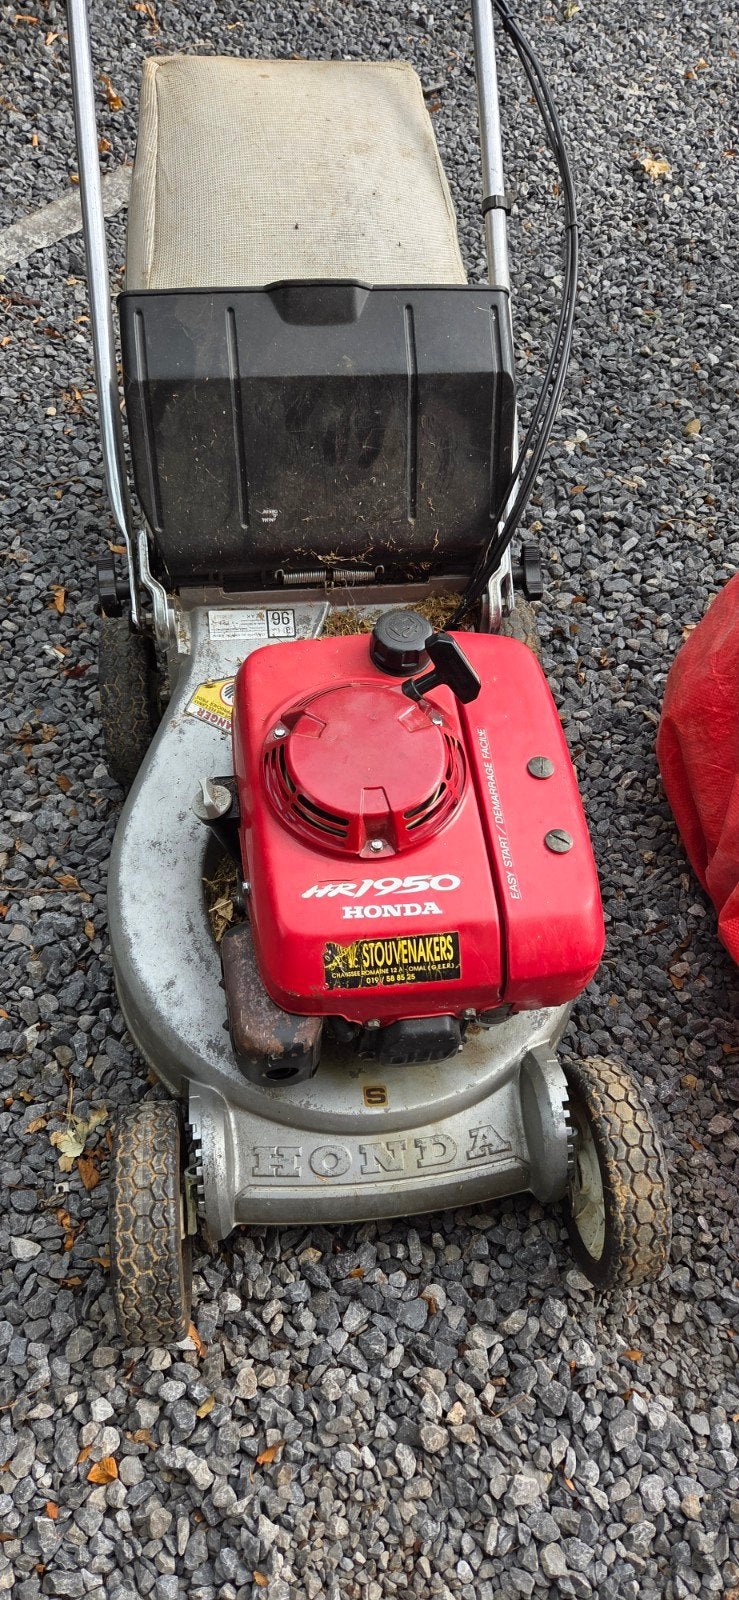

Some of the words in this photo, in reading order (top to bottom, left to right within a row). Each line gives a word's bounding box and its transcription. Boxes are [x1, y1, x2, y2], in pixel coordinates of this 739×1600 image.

[271, 611, 290, 625] 96
[197, 707, 232, 730] ANGER
[498, 835, 513, 868] START
[505, 872, 520, 900] EASY
[342, 902, 443, 919] HONDA
[362, 934, 454, 968] STOUVENAKERS
[366, 976, 379, 984] 019
[386, 974, 395, 982] 58
[406, 972, 416, 980] 25
[365, 1087, 386, 1105] S
[251, 1125, 512, 1178] HONDA
